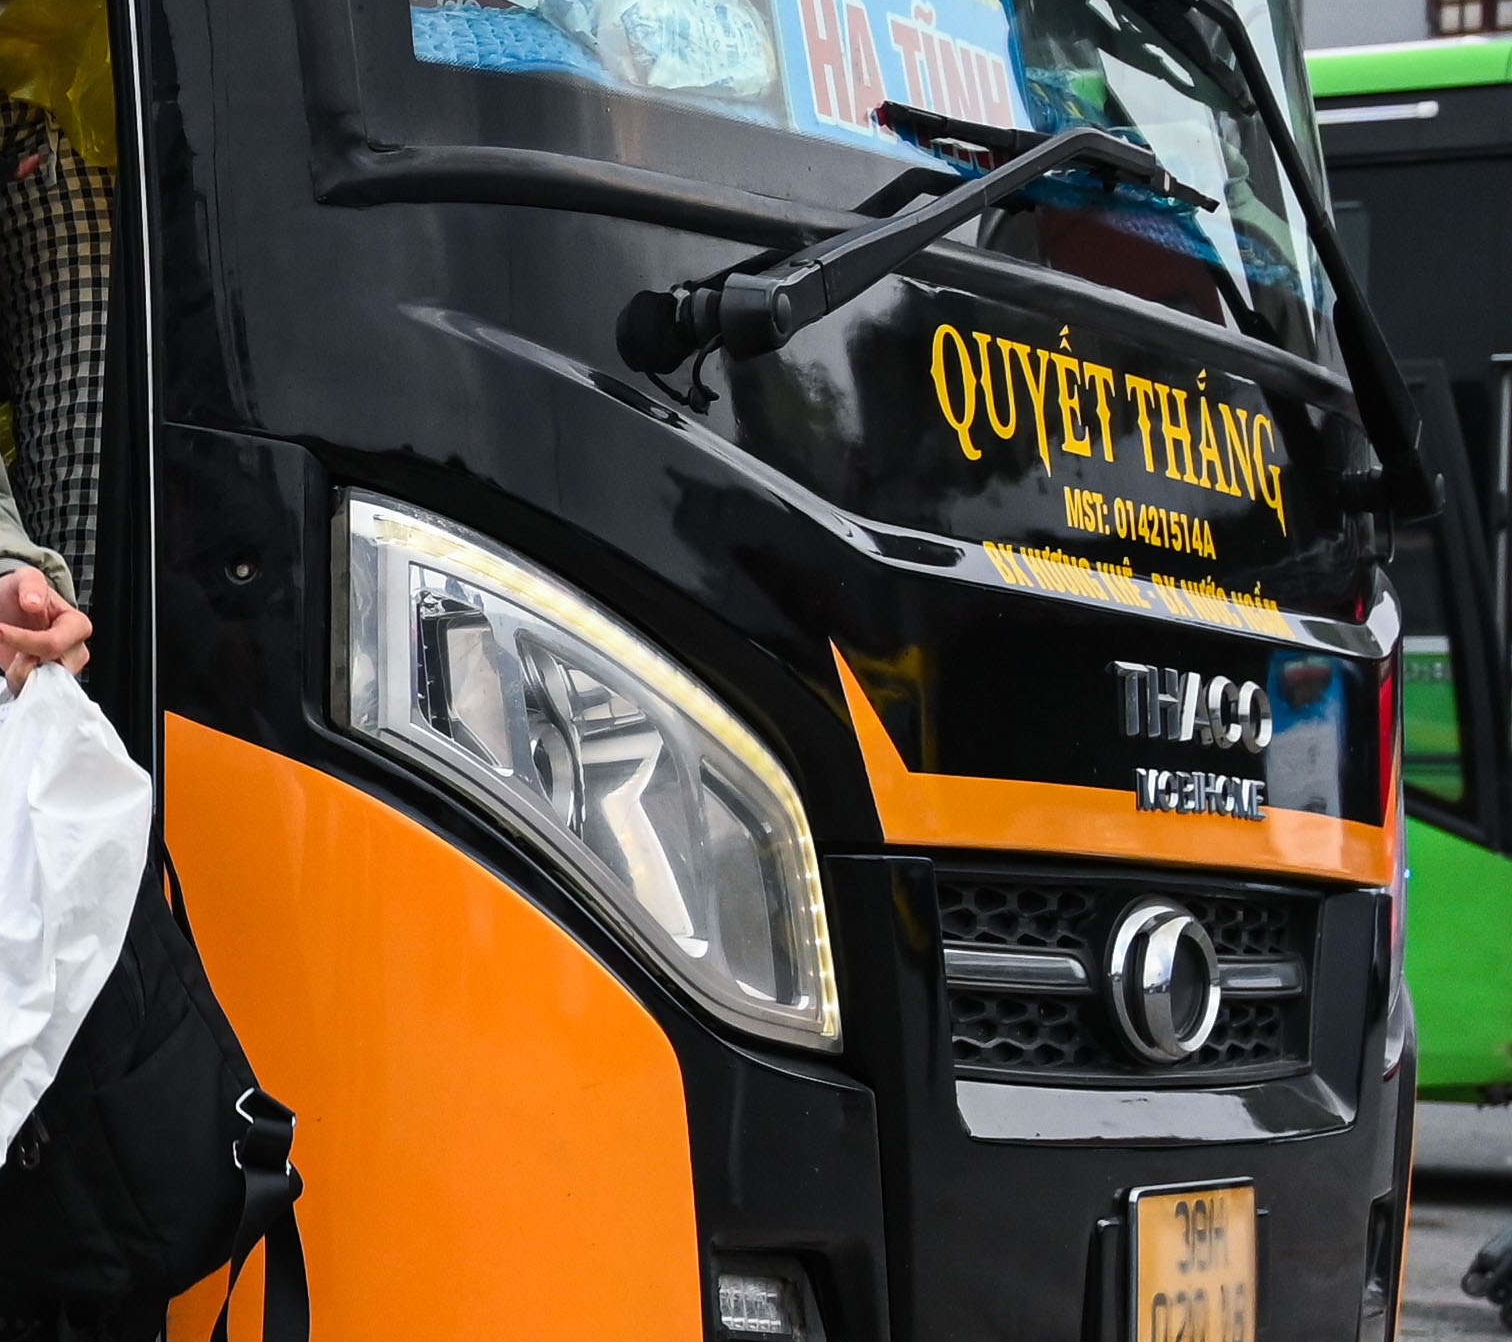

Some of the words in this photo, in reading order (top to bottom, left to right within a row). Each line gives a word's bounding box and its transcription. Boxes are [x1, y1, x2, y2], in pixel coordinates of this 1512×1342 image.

[930, 324, 1115, 478] QUYẾT
[1125, 368, 1287, 537] THẮNG
[1064, 486, 1111, 535] MST:
[1114, 504, 1217, 560] 01421514A
[982, 540, 1034, 588] BX
[1020, 546, 1110, 602] HƯƠNG
[1096, 556, 1153, 610] KHÊ
[1151, 572, 1194, 617] BX
[1181, 575, 1244, 628] NƯỚC
[1231, 581, 1297, 639] NGẦM
[1107, 660, 1273, 754] THACO
[1135, 767, 1267, 822] MOBIHOME
